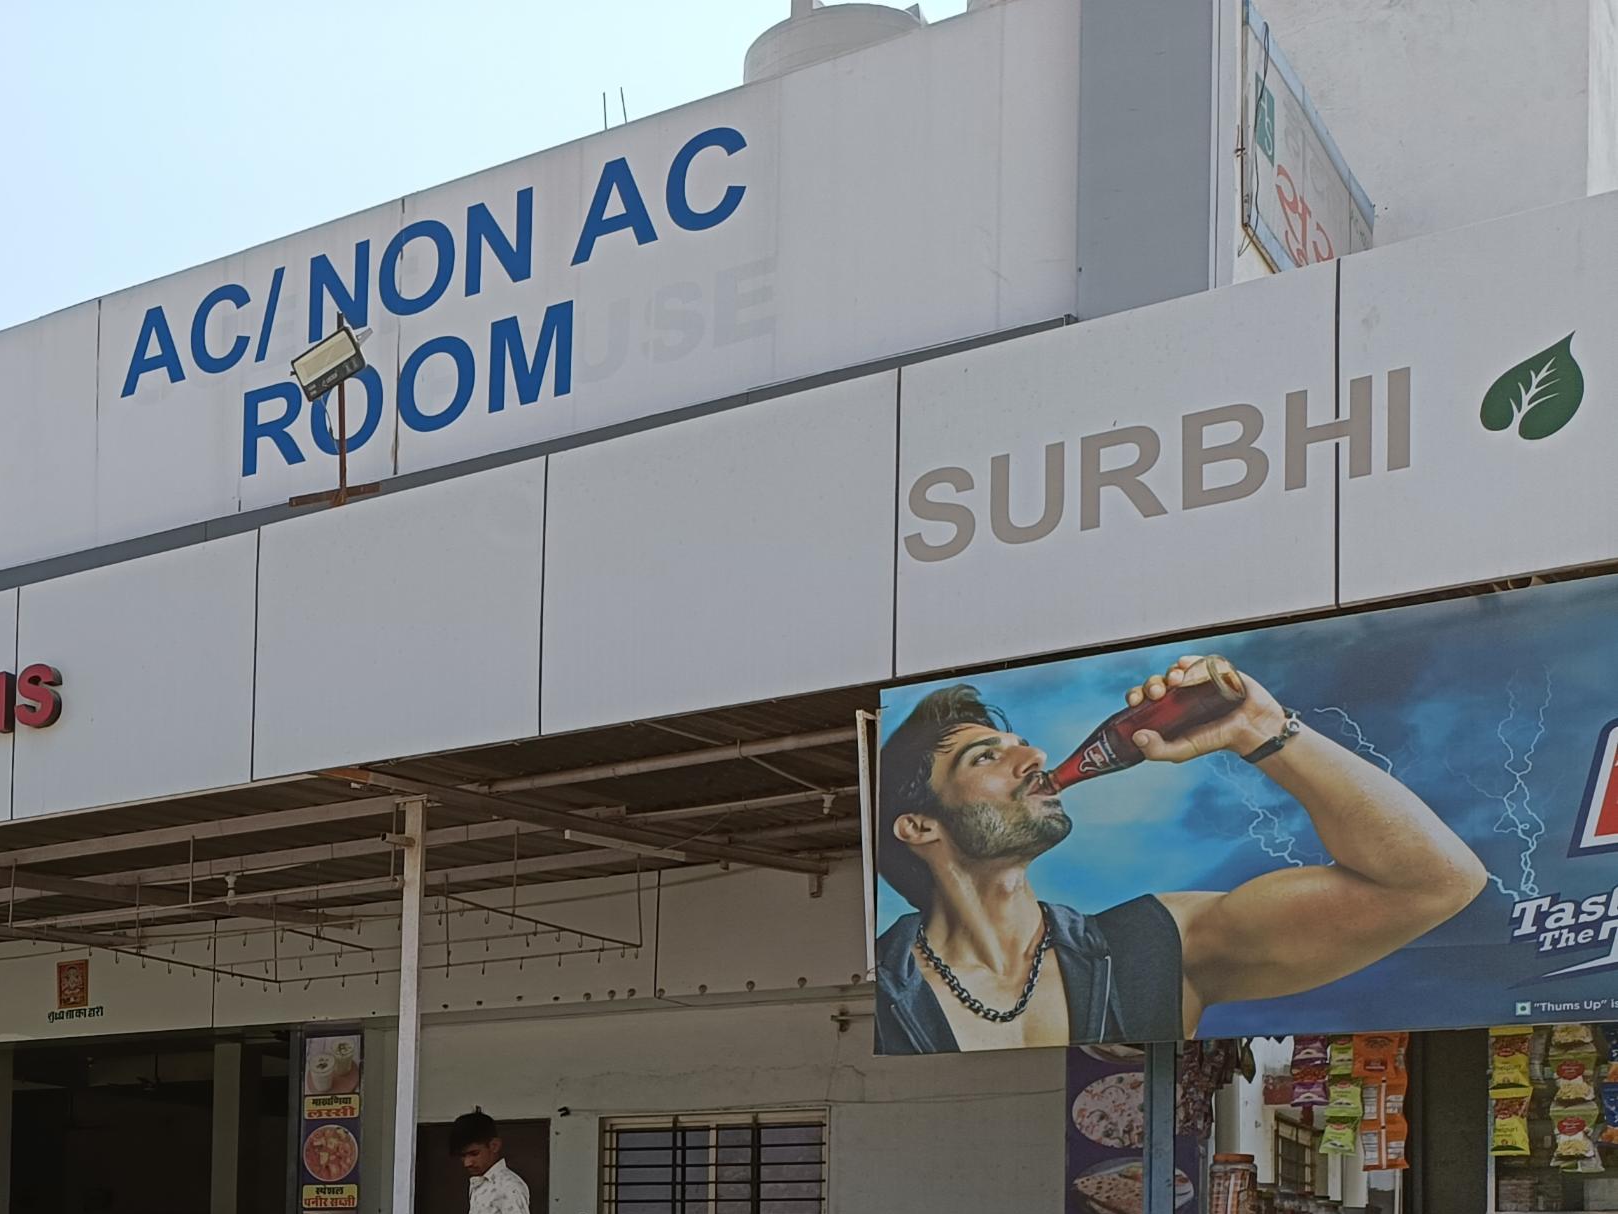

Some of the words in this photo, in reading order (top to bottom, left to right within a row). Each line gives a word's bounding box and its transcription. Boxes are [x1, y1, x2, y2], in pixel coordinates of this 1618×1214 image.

[570, 126, 748, 267] AC
[241, 299, 574, 478] ROOM
[903, 366, 1411, 563] SURBHI
[1538, 928, 1595, 953] The
